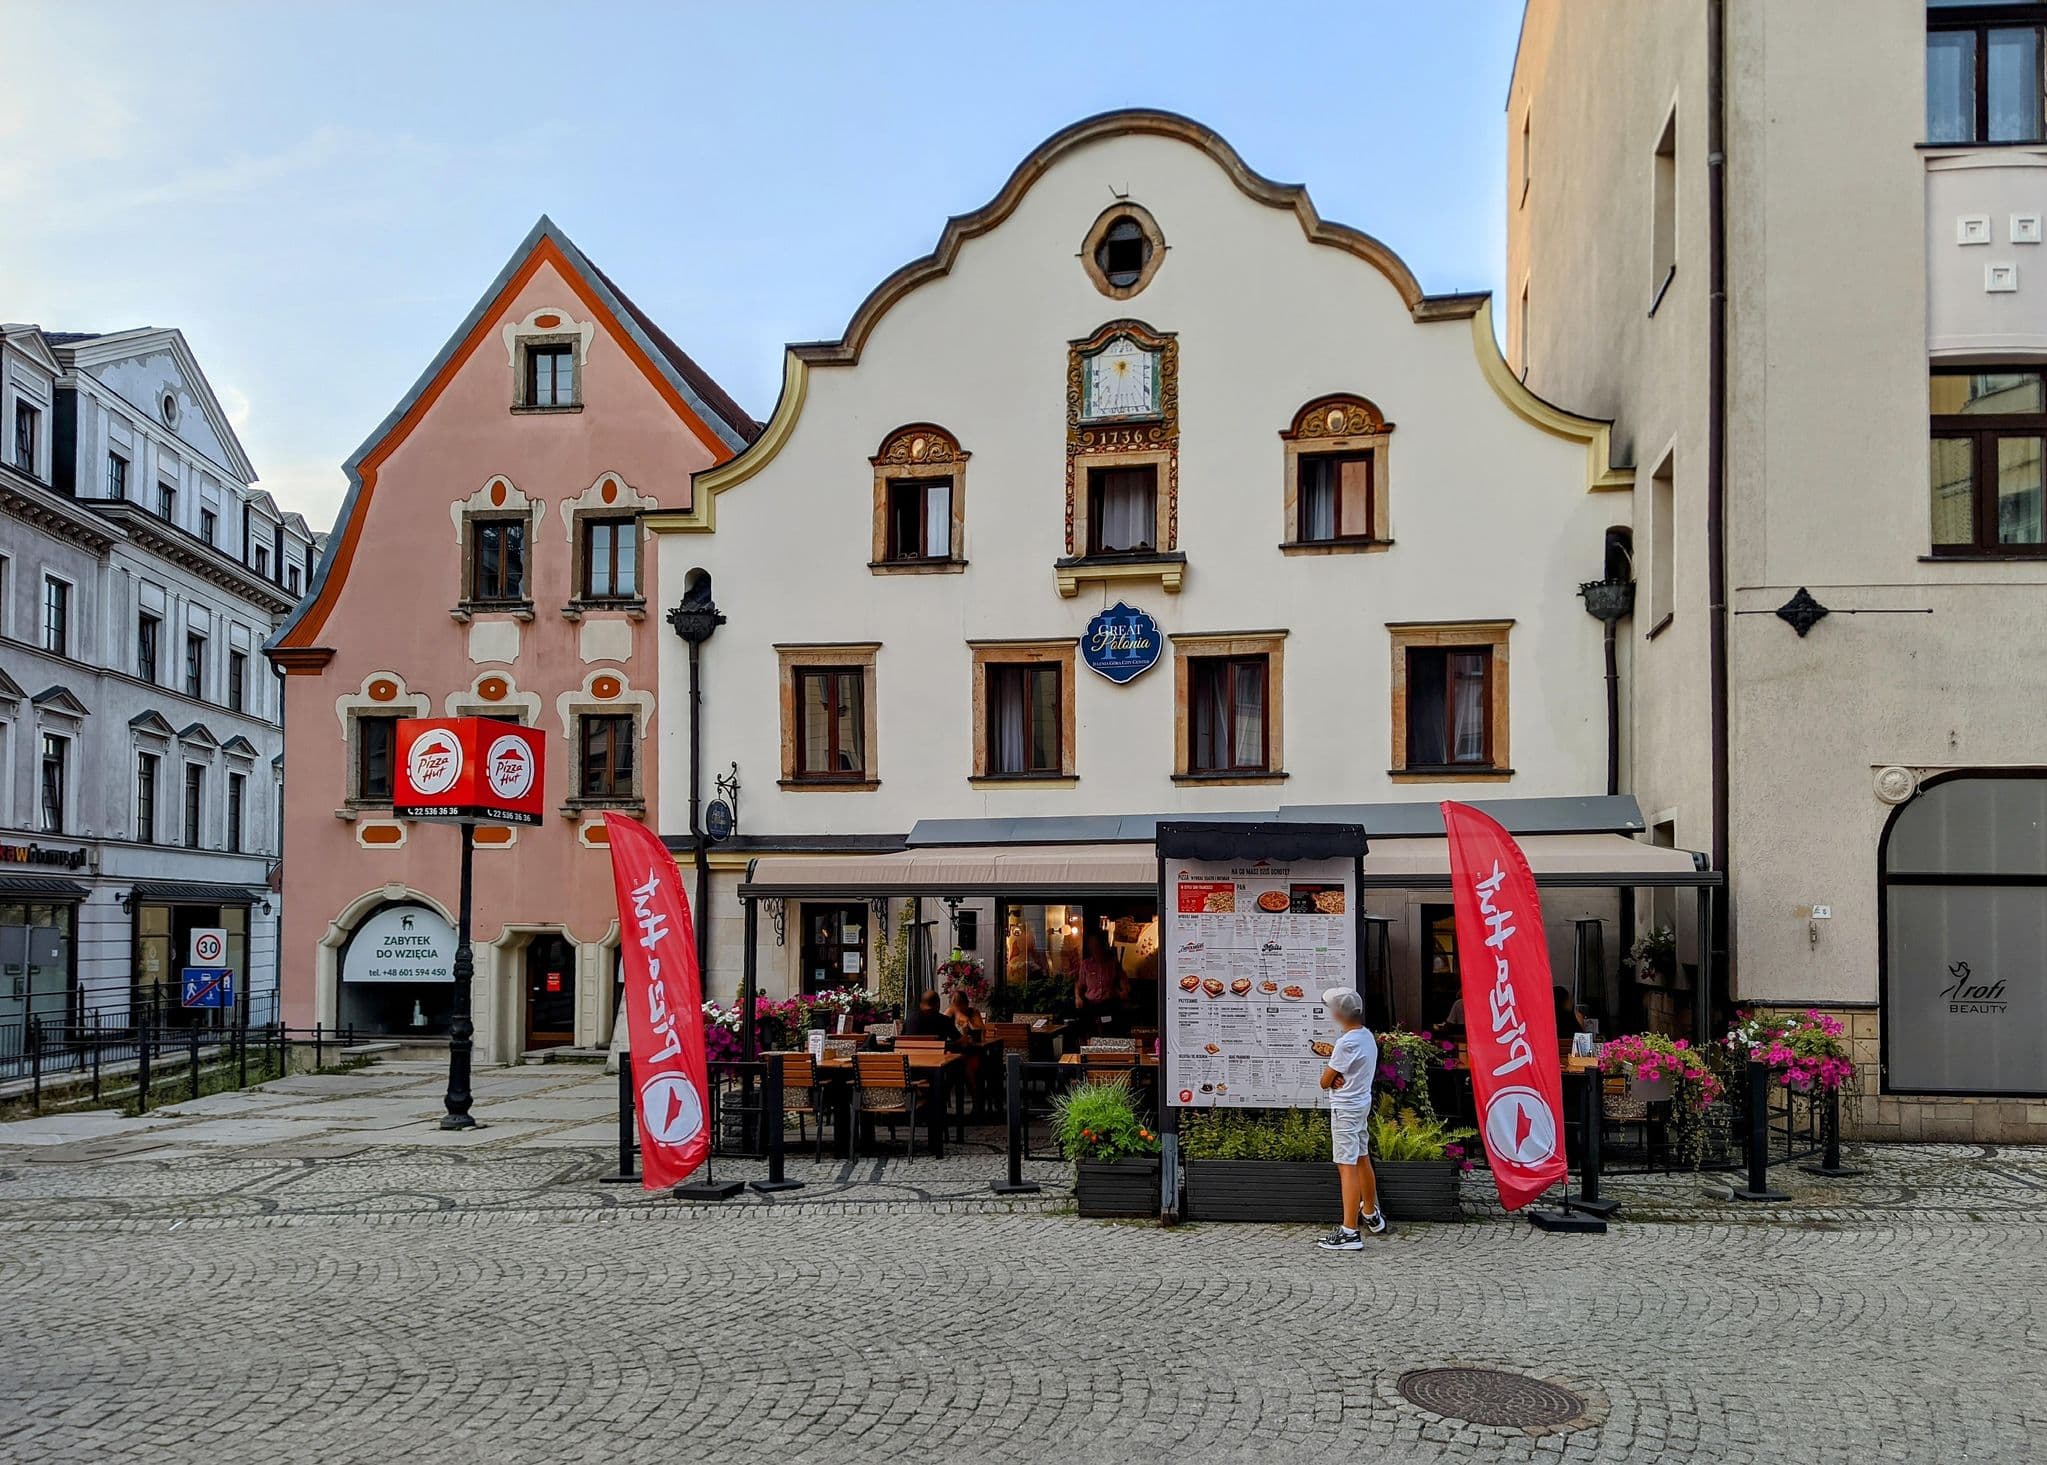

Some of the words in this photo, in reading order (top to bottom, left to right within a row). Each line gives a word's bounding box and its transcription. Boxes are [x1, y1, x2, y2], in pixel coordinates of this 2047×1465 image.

[1100, 430, 1143, 445] 1736
[1098, 624, 1144, 636] GREAT
[1091, 633, 1151, 652] Polonia
[418, 756, 449, 774] Pizza
[495, 760, 523, 776] Pizza
[422, 767, 446, 783] Hut
[500, 773, 522, 787] Hut
[414, 807, 424, 816] 22
[425, 807, 438, 816] 536
[438, 807, 448, 816] 36
[449, 807, 459, 815] 36
[493, 809, 501, 818] 22
[502, 811, 513, 820] 536
[514, 812, 523, 821] 36
[523, 813, 531, 822] 36
[200, 941, 218, 954] 30
[384, 936, 431, 946] ZABYTEK
[376, 949, 393, 959] DO
[395, 949, 438, 960] WZIĘCIA
[369, 968, 381, 977] tel.
[382, 968, 397, 977] +48
[399, 968, 413, 977] 601
[415, 968, 430, 977] 594
[431, 968, 447, 977] 450
[1950, 1005, 2008, 1014] BEAUTY
